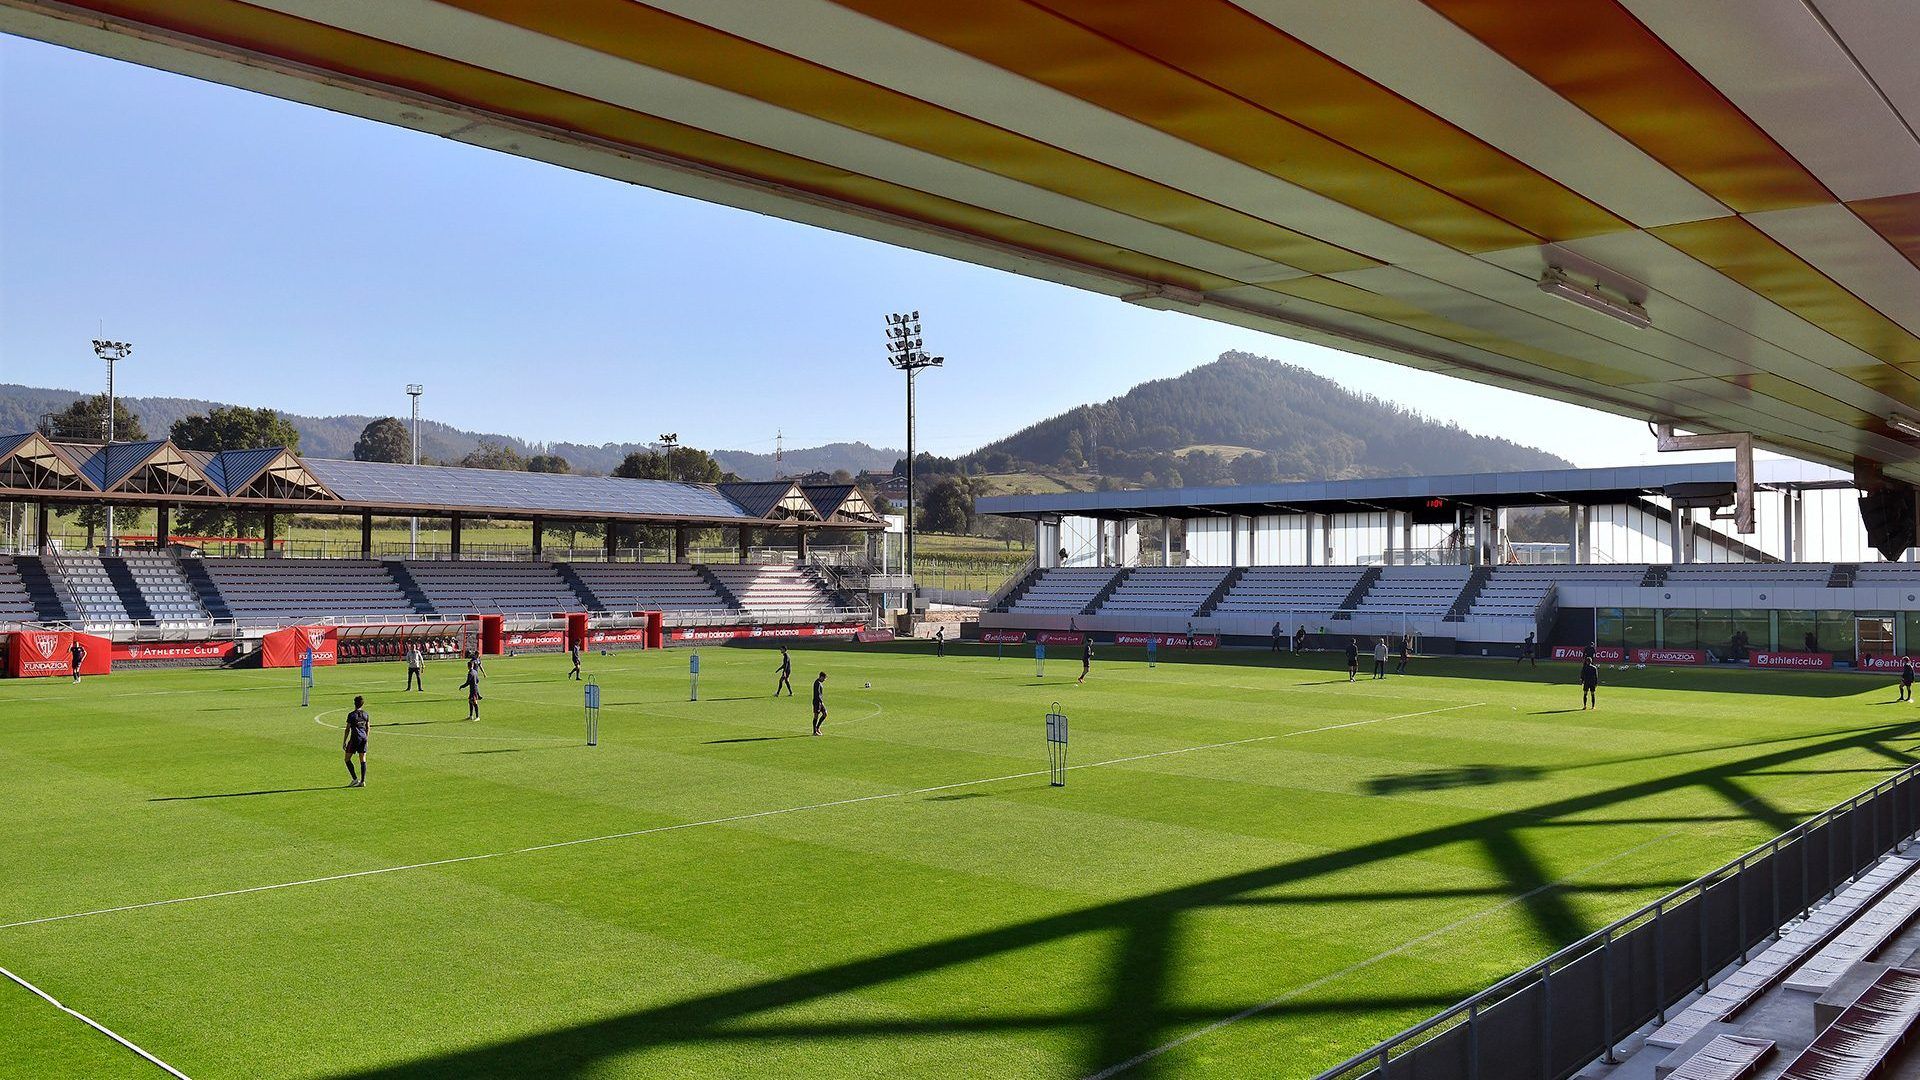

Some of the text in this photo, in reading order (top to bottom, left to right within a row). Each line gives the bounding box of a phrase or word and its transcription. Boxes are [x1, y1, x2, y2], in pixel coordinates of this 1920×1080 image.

[709, 630, 734, 638] balance
[836, 626, 858, 634] balance
[143, 645, 220, 656] ATHLETIC CLUB
[1769, 656, 1823, 666] athleticclub
